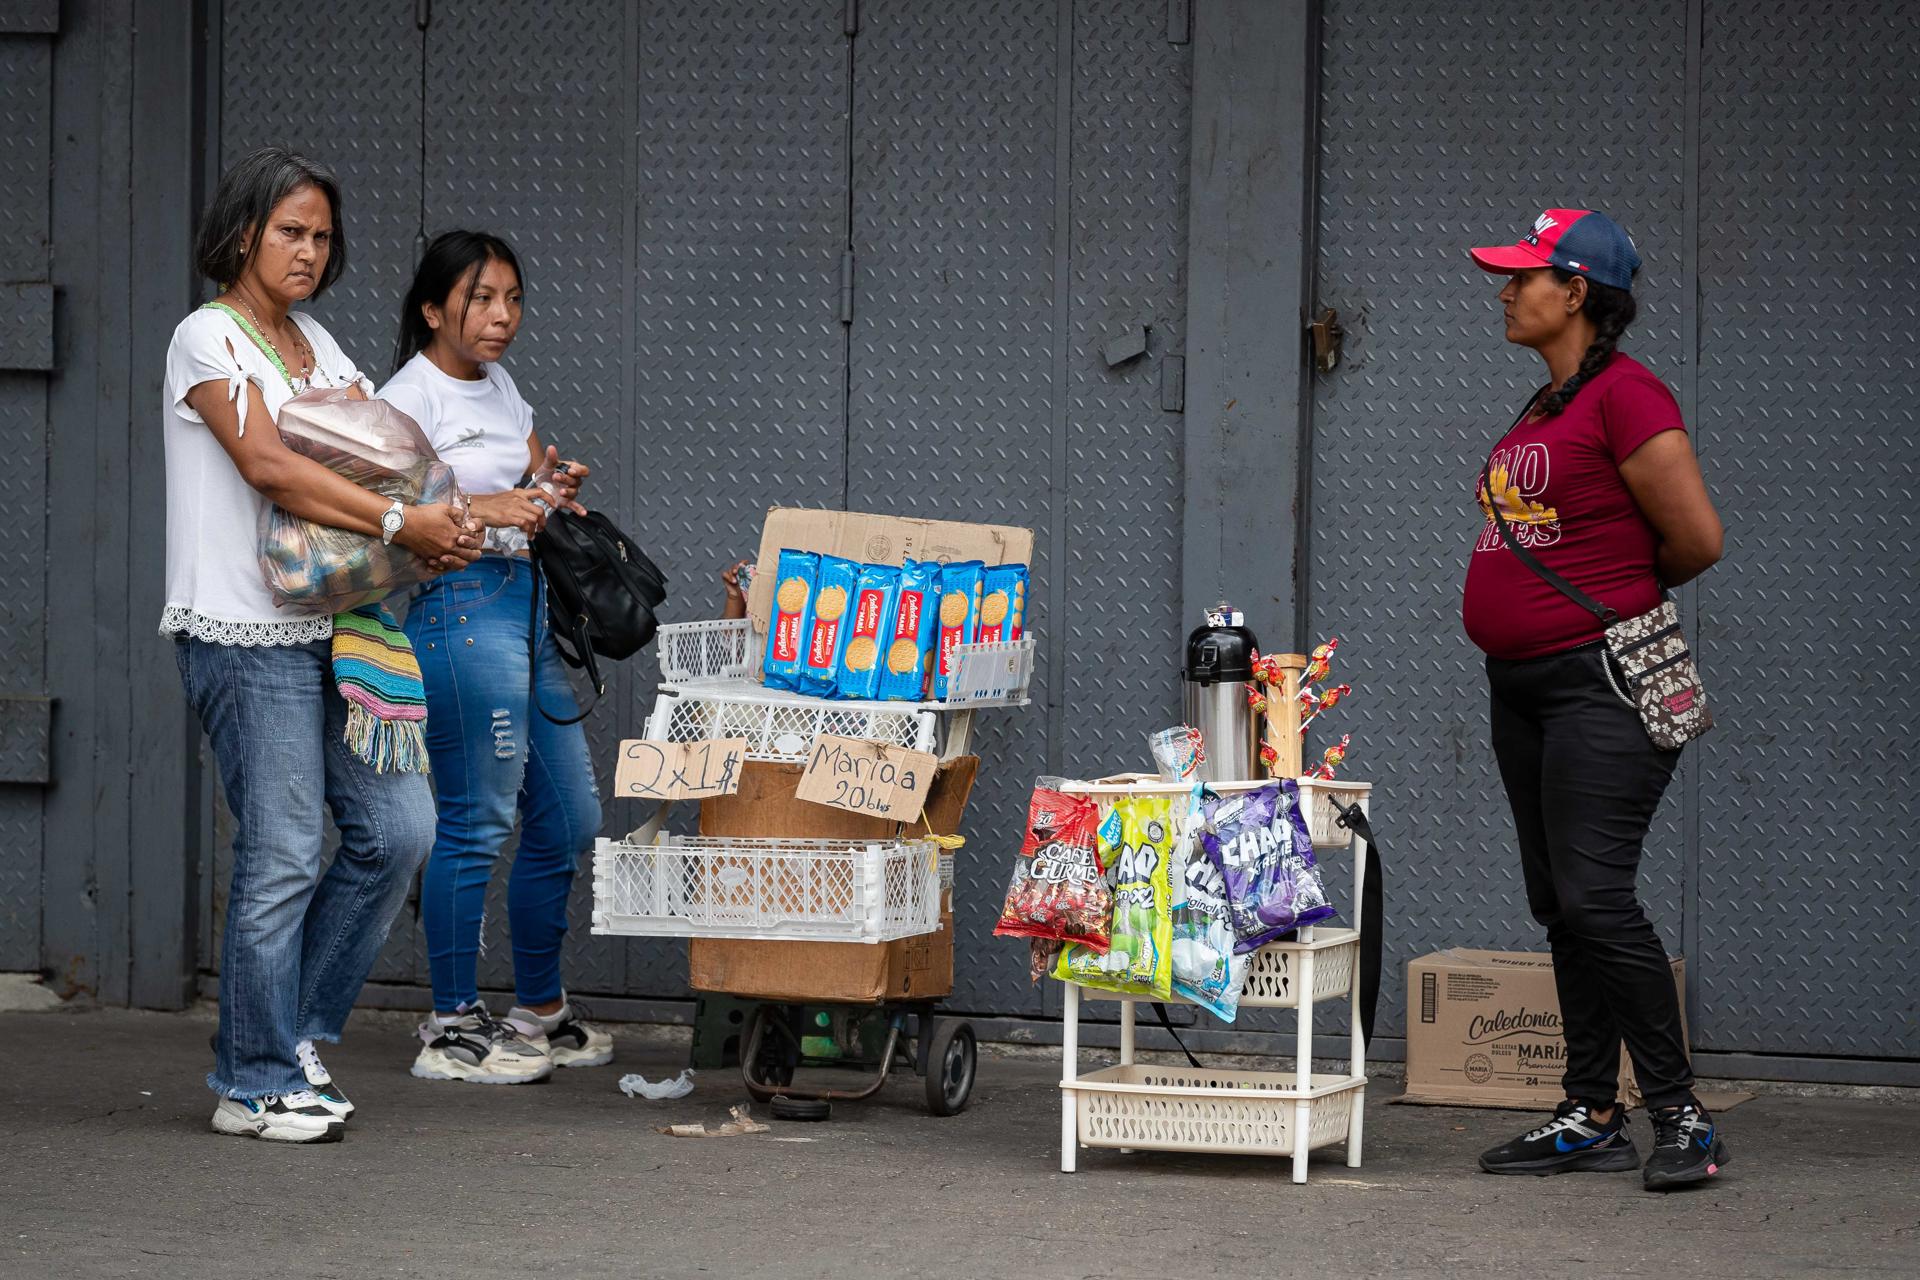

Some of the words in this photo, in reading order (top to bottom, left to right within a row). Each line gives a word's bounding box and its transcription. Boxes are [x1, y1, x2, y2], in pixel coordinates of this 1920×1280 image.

[868, 593, 879, 629] Caledonia
[907, 592, 918, 631] Caledonia
[778, 617, 789, 657] Caledonia
[813, 628, 824, 664] Caledonia
[1221, 818, 1293, 867] CHAO
[1469, 1007, 1558, 1040] Caledonia
[1526, 1077, 1538, 1086] 24
